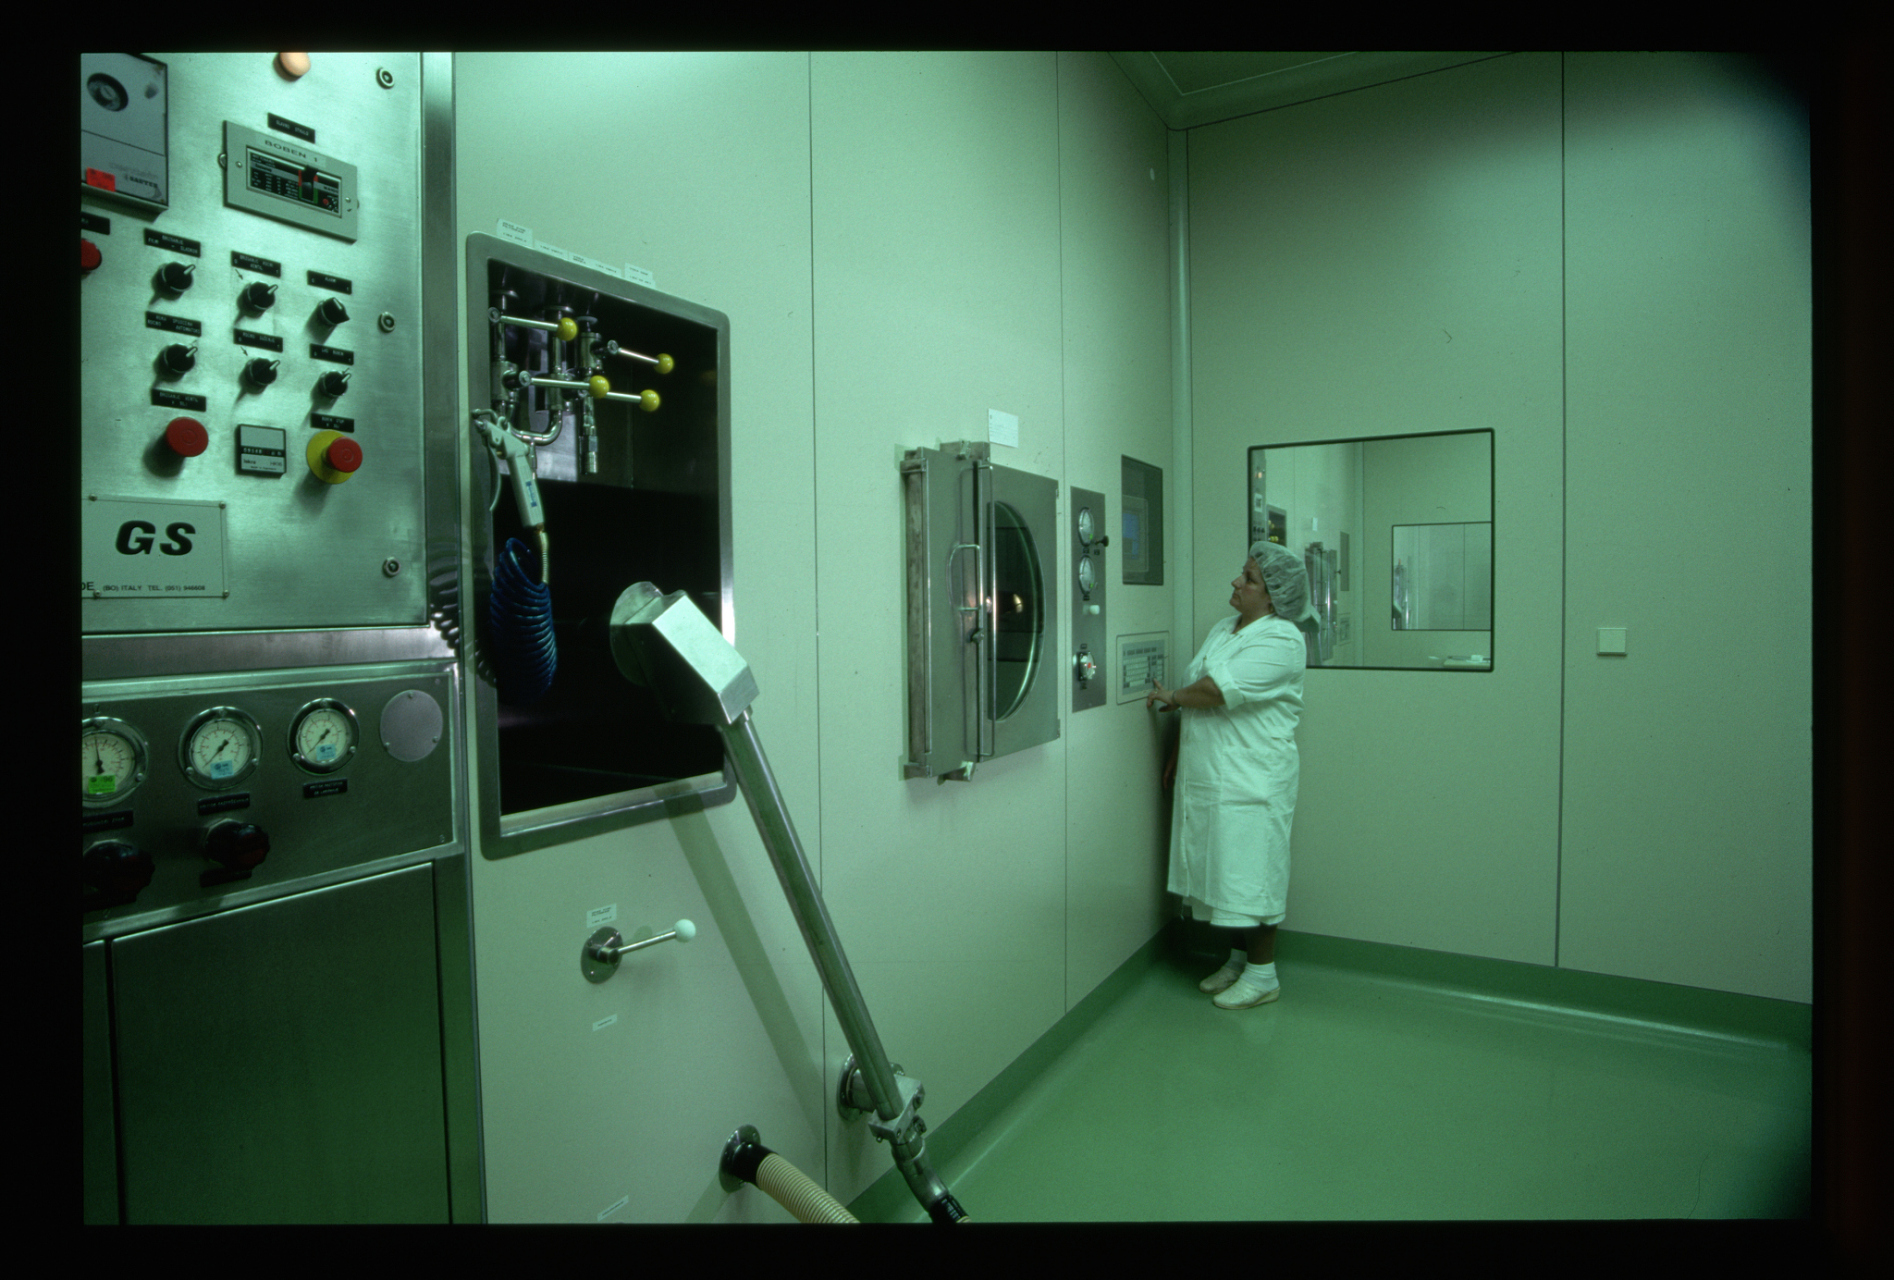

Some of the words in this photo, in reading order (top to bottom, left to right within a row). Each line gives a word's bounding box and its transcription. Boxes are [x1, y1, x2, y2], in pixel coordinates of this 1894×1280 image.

[264, 139, 306, 159] BOBEN
[115, 519, 197, 556] GS
[102, 584, 119, 592] (BO)
[121, 584, 143, 592] ITALY
[147, 584, 163, 592] TEL.
